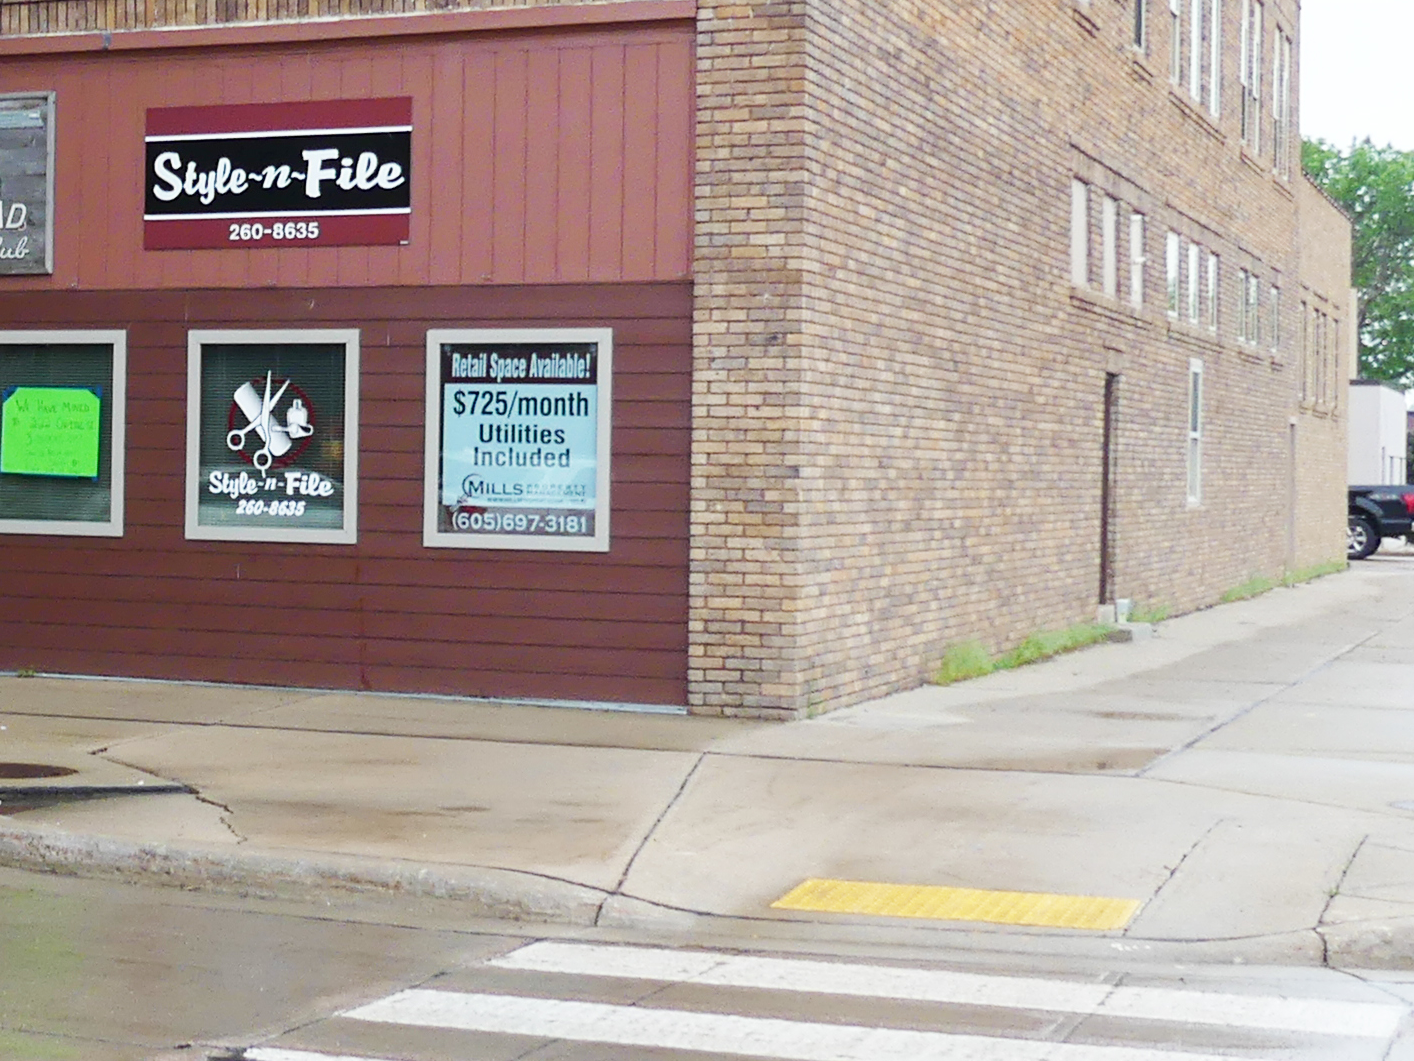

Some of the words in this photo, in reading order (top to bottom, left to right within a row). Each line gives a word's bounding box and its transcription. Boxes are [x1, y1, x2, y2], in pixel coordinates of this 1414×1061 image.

[153, 148, 405, 205] Style-n-File
[229, 222, 319, 240] 260-8635
[452, 353, 486, 378] Retail
[489, 353, 526, 382] Space
[529, 353, 591, 378] Available!
[454, 389, 589, 418] $725/month
[479, 424, 566, 444] Utilities
[474, 446, 570, 468] Included
[209, 471, 334, 499] Style-n-File
[468, 480, 523, 495] MILLS
[236, 499, 305, 517] 260-8635
[452, 511, 586, 533] (605)697-3181
